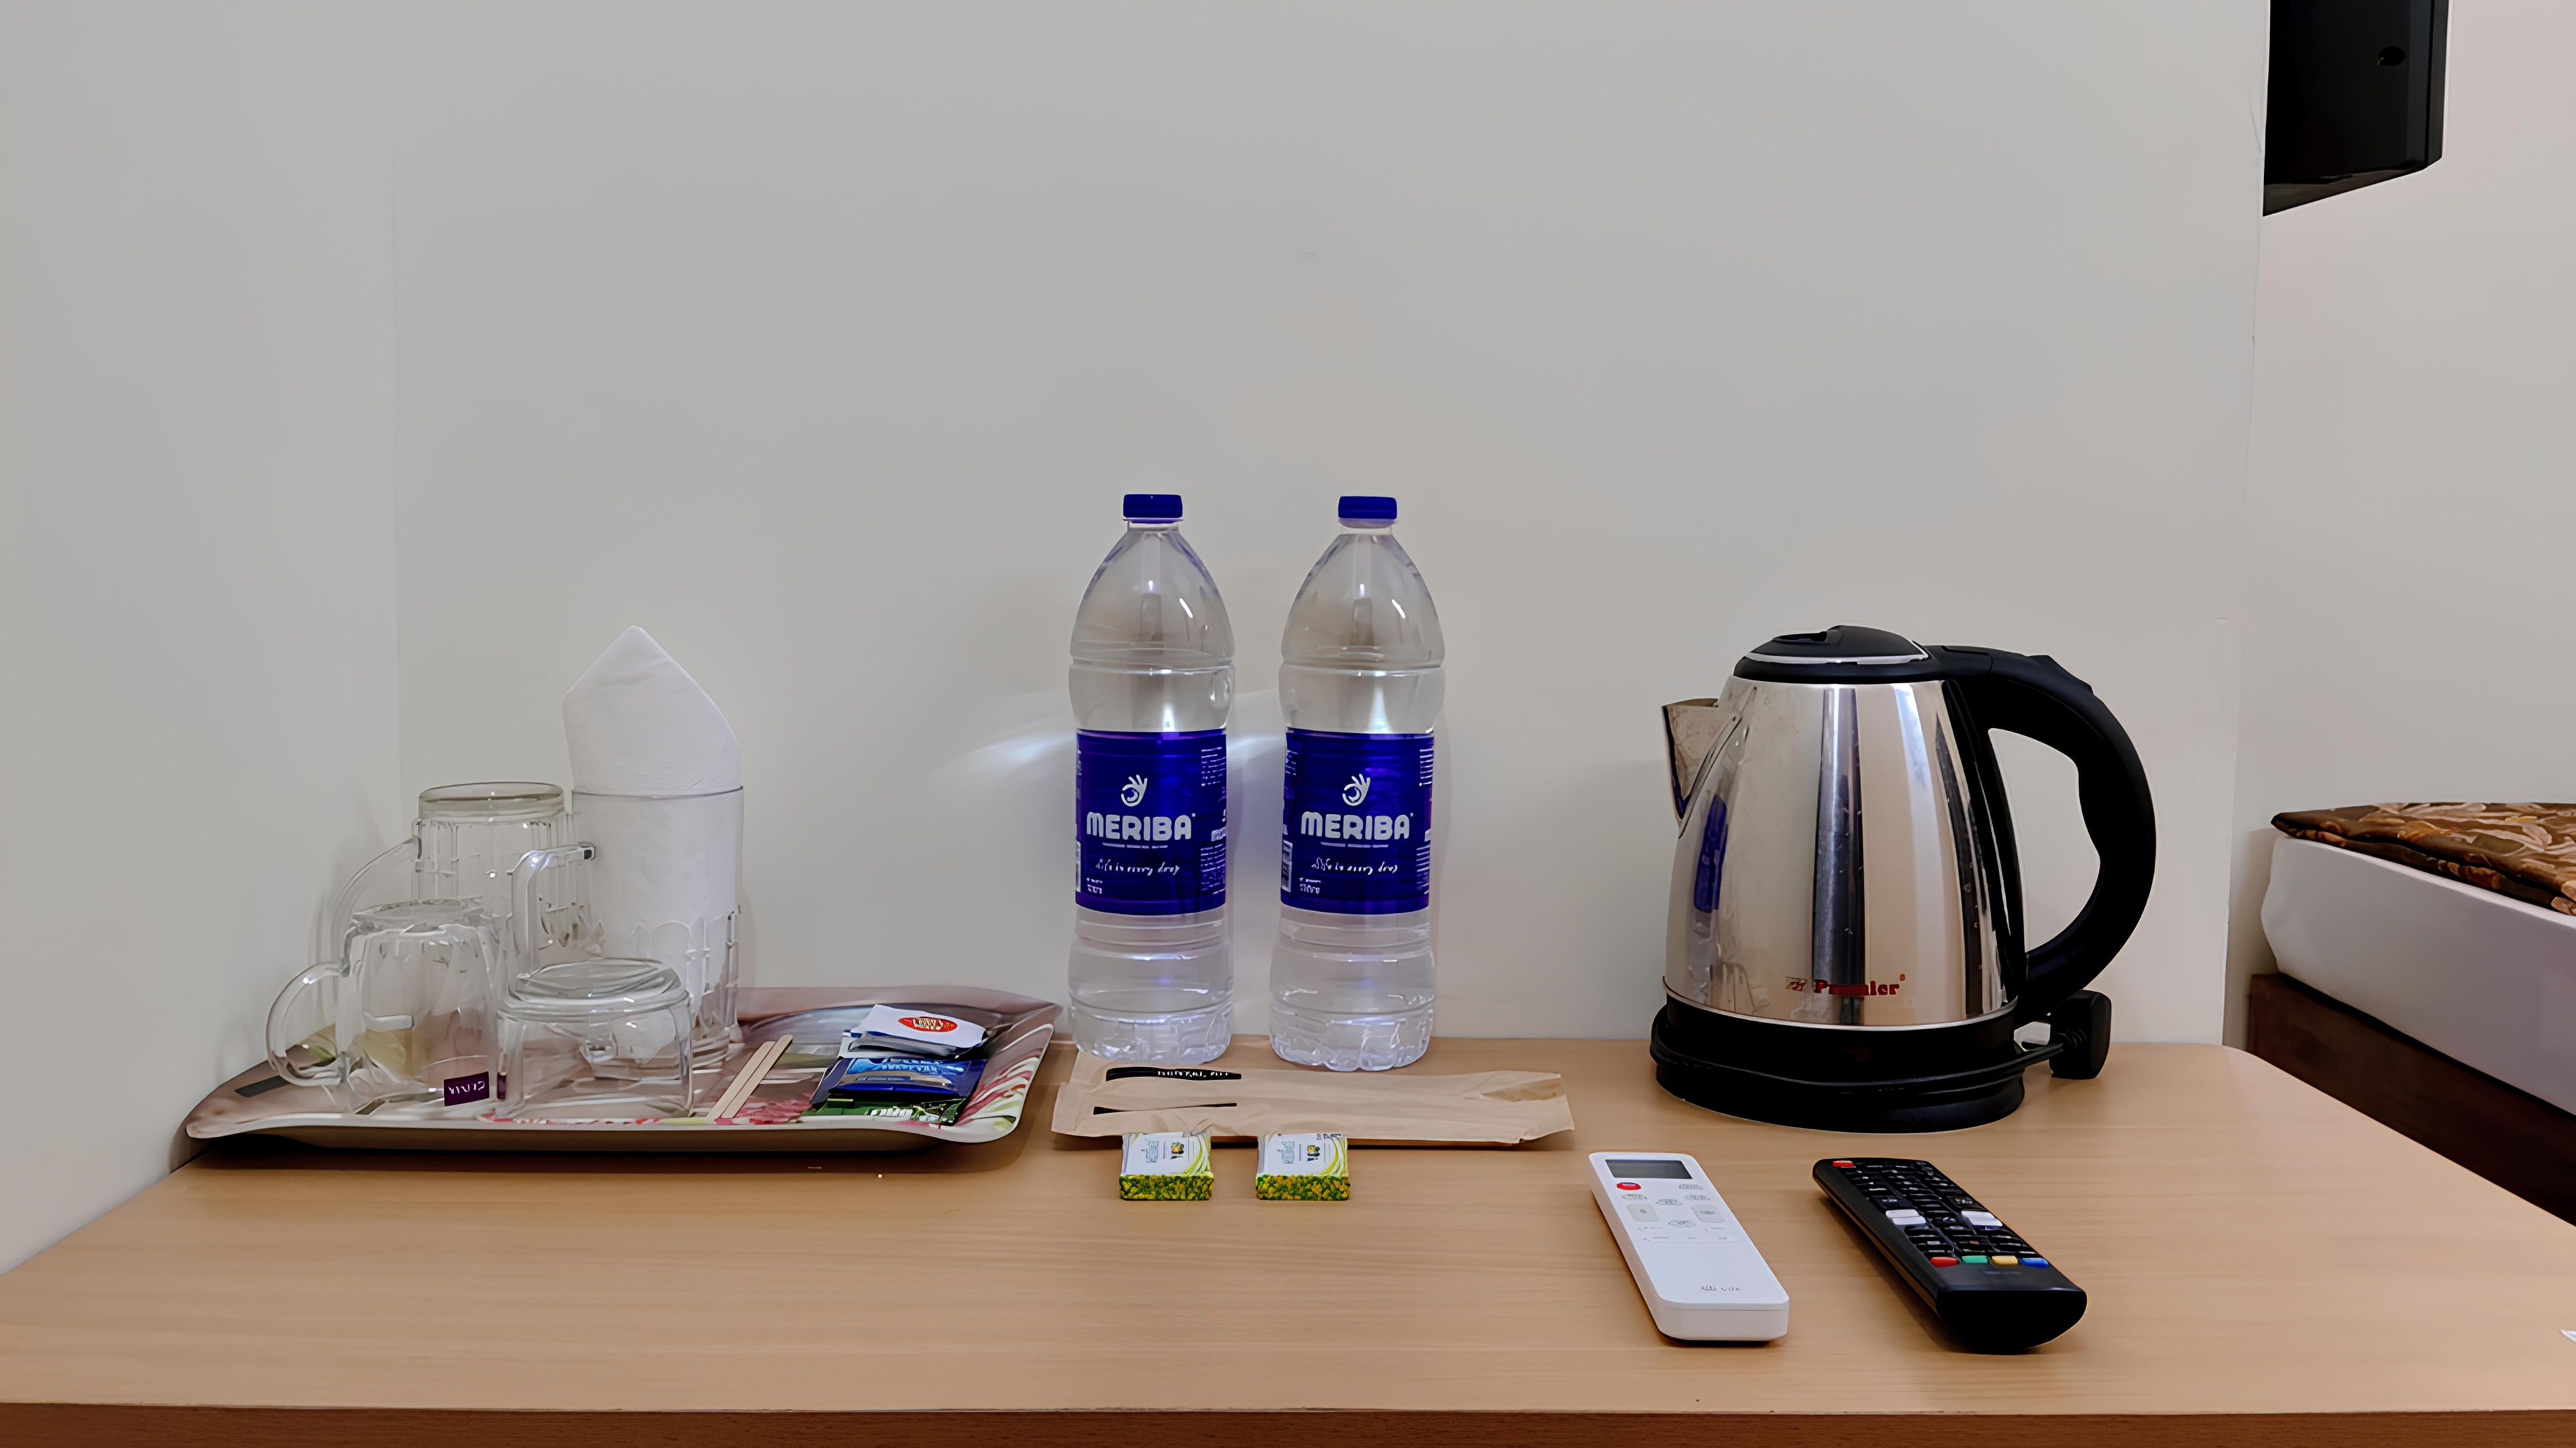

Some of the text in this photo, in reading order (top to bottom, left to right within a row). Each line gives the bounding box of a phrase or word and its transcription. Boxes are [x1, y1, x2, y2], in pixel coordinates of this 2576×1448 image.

[1086, 811, 1191, 841] MERIBA
[1301, 811, 1409, 841] MERIBA
[1814, 978, 1900, 996] Pier
